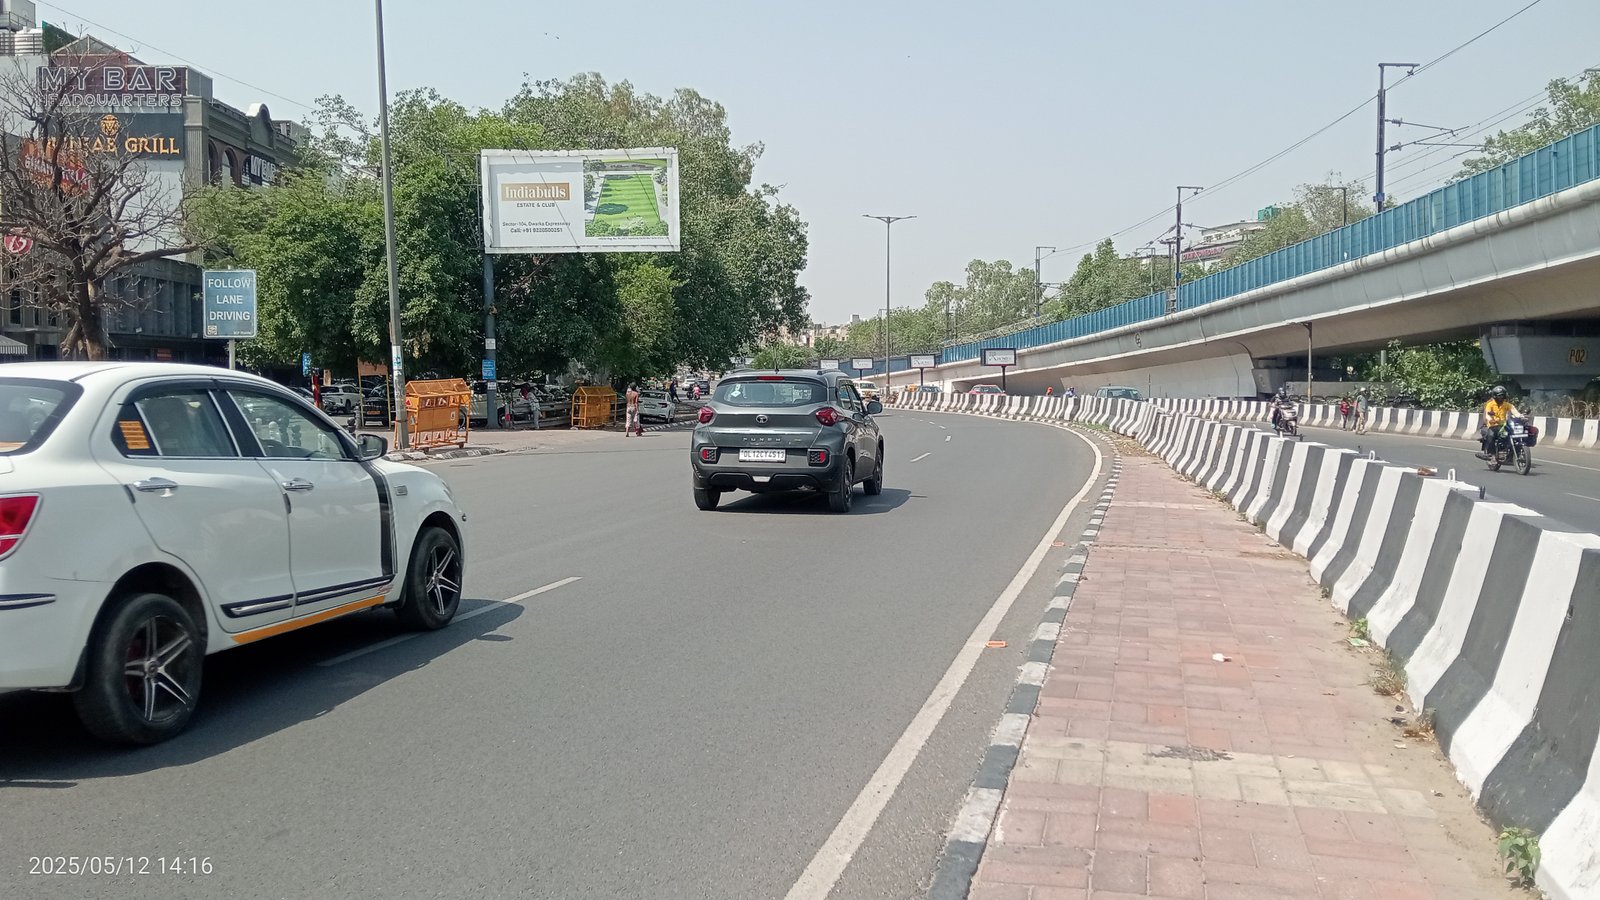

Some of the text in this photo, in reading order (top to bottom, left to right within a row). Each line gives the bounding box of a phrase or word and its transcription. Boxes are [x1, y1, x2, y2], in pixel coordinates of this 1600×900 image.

[41, 66, 177, 91] MY BAR
[125, 137, 180, 154] GRILL
[505, 186, 567, 199] Indiabulls
[208, 278, 251, 289] FOLLOW
[216, 295, 244, 304] LANE
[209, 311, 251, 321] DRIVING
